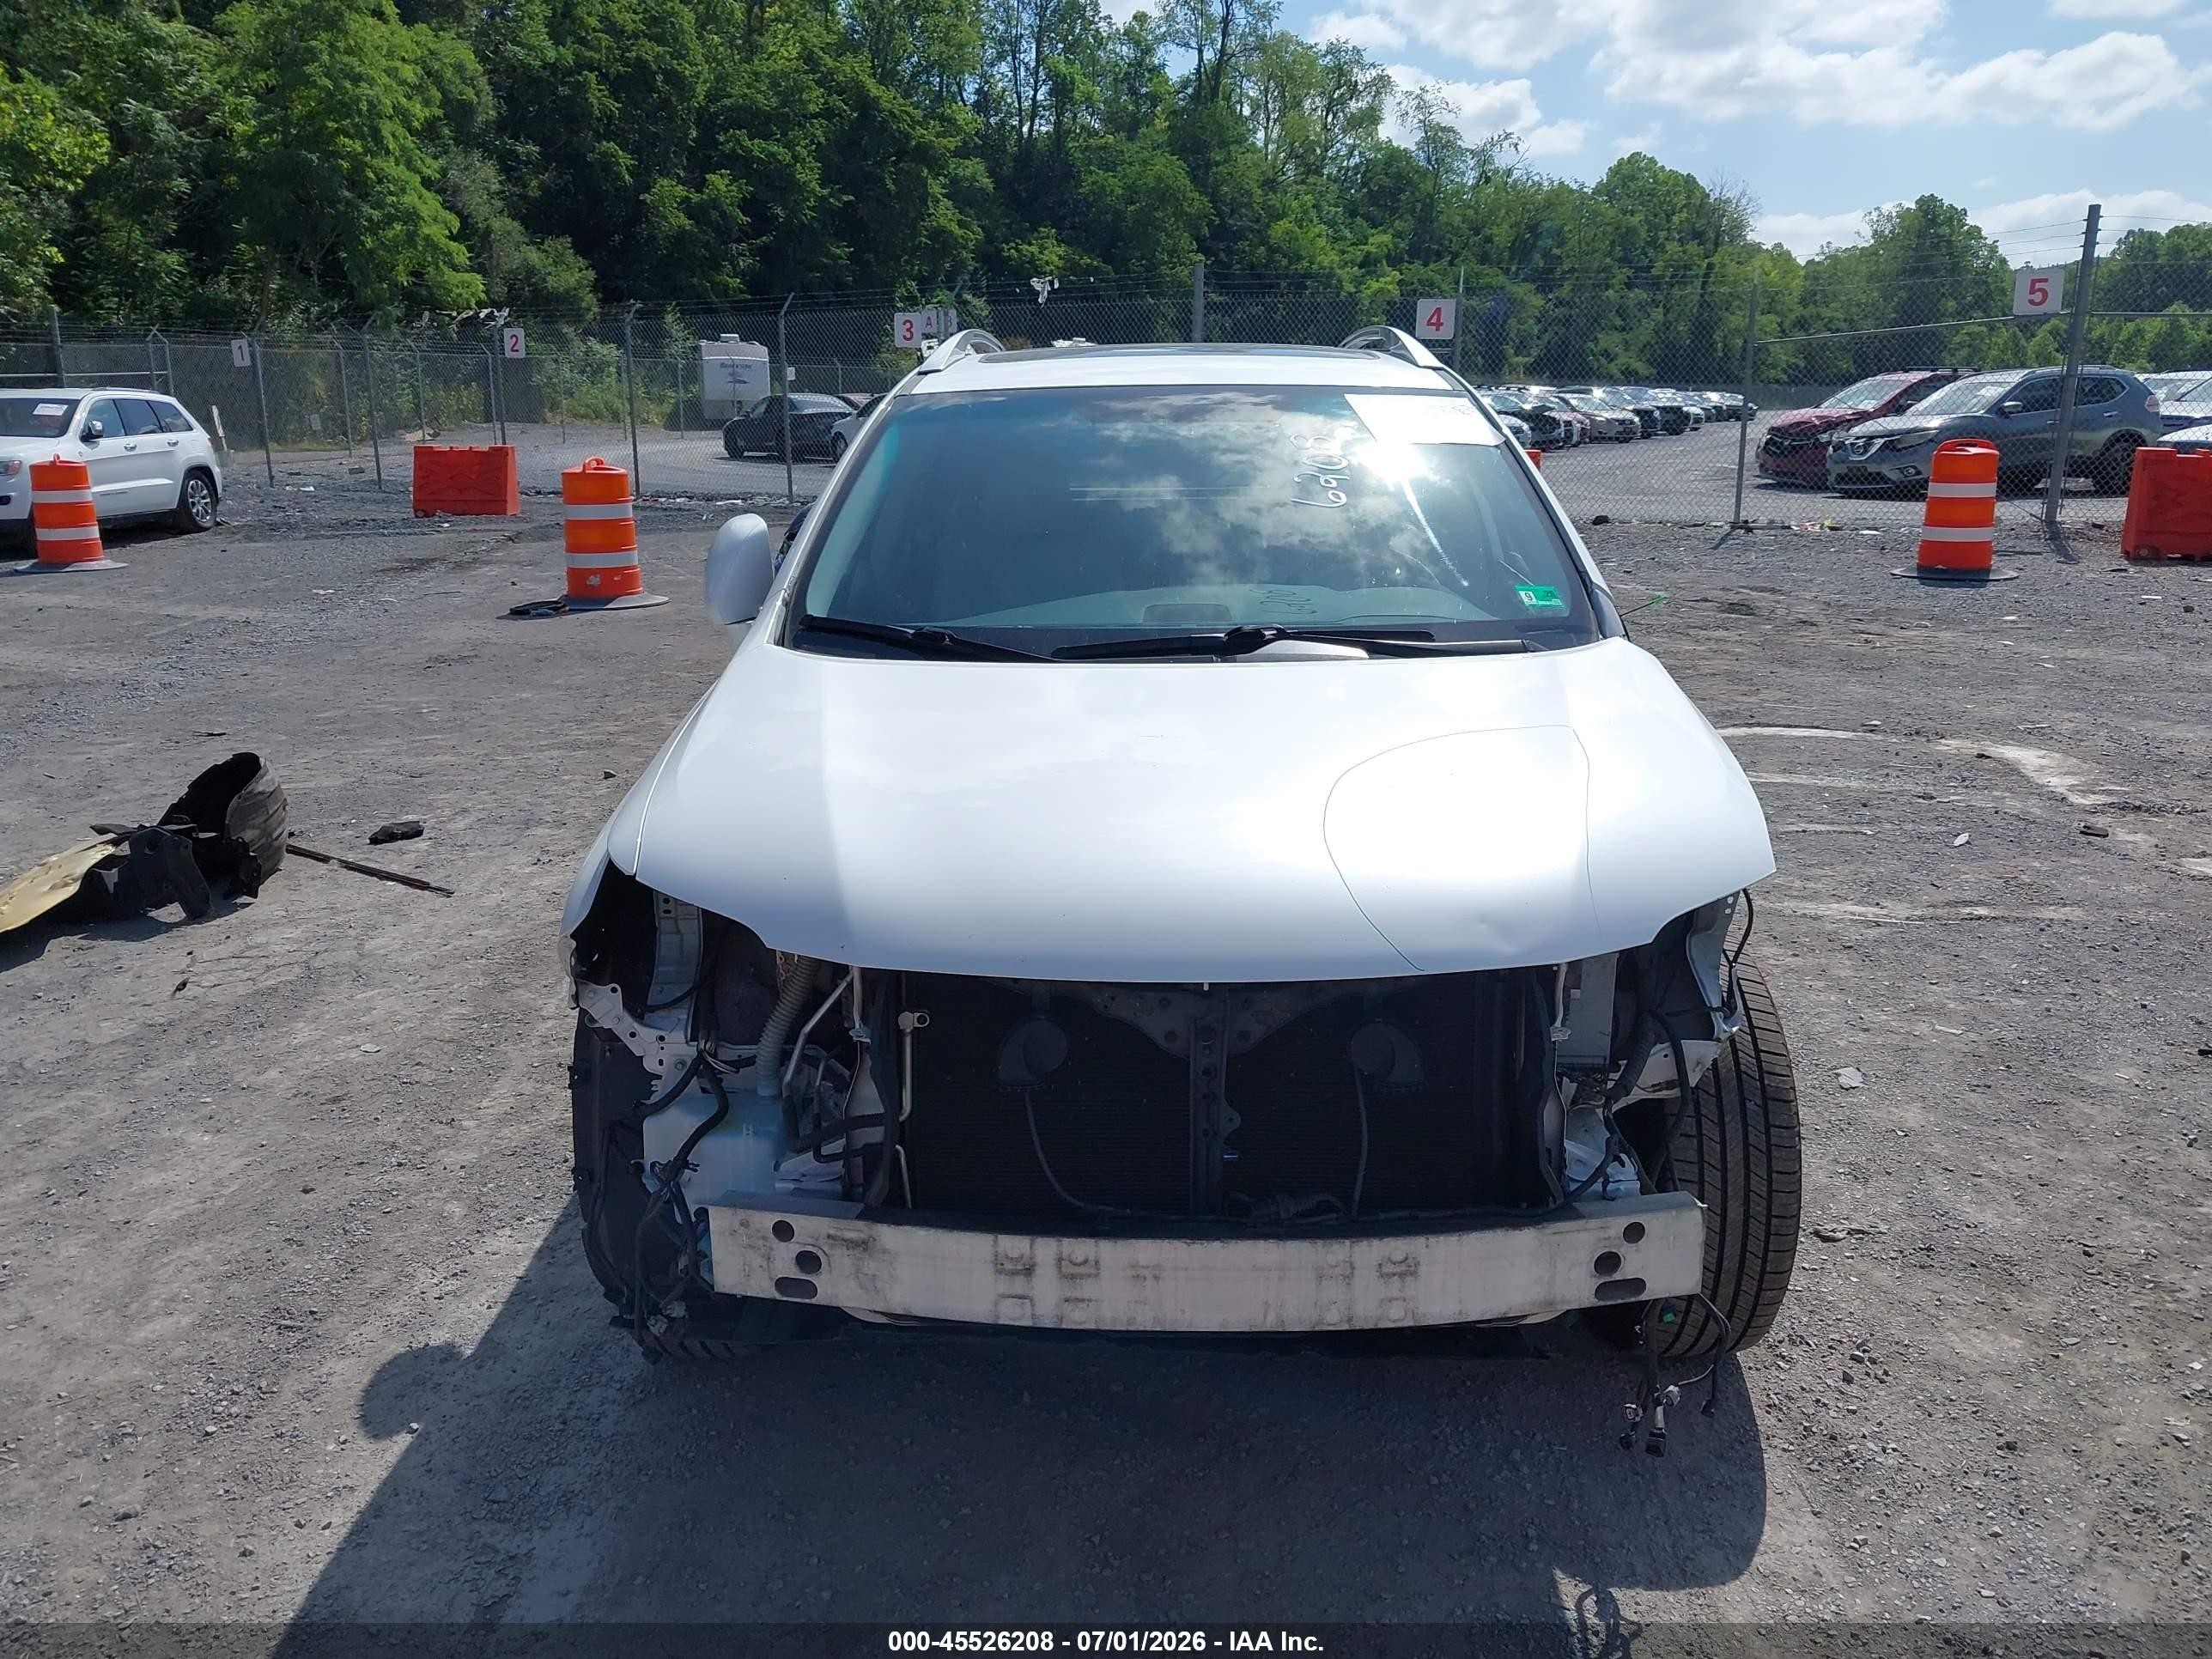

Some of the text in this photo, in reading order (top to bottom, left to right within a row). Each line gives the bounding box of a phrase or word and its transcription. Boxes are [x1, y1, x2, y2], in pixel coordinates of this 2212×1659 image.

[2027, 277, 2049, 307] 5
[925, 315, 933, 328] A
[1425, 307, 1444, 331] 4
[902, 319, 915, 342] 3
[509, 334, 520, 352] 2
[237, 344, 245, 361] 1
[1524, 592, 1533, 601] 9
